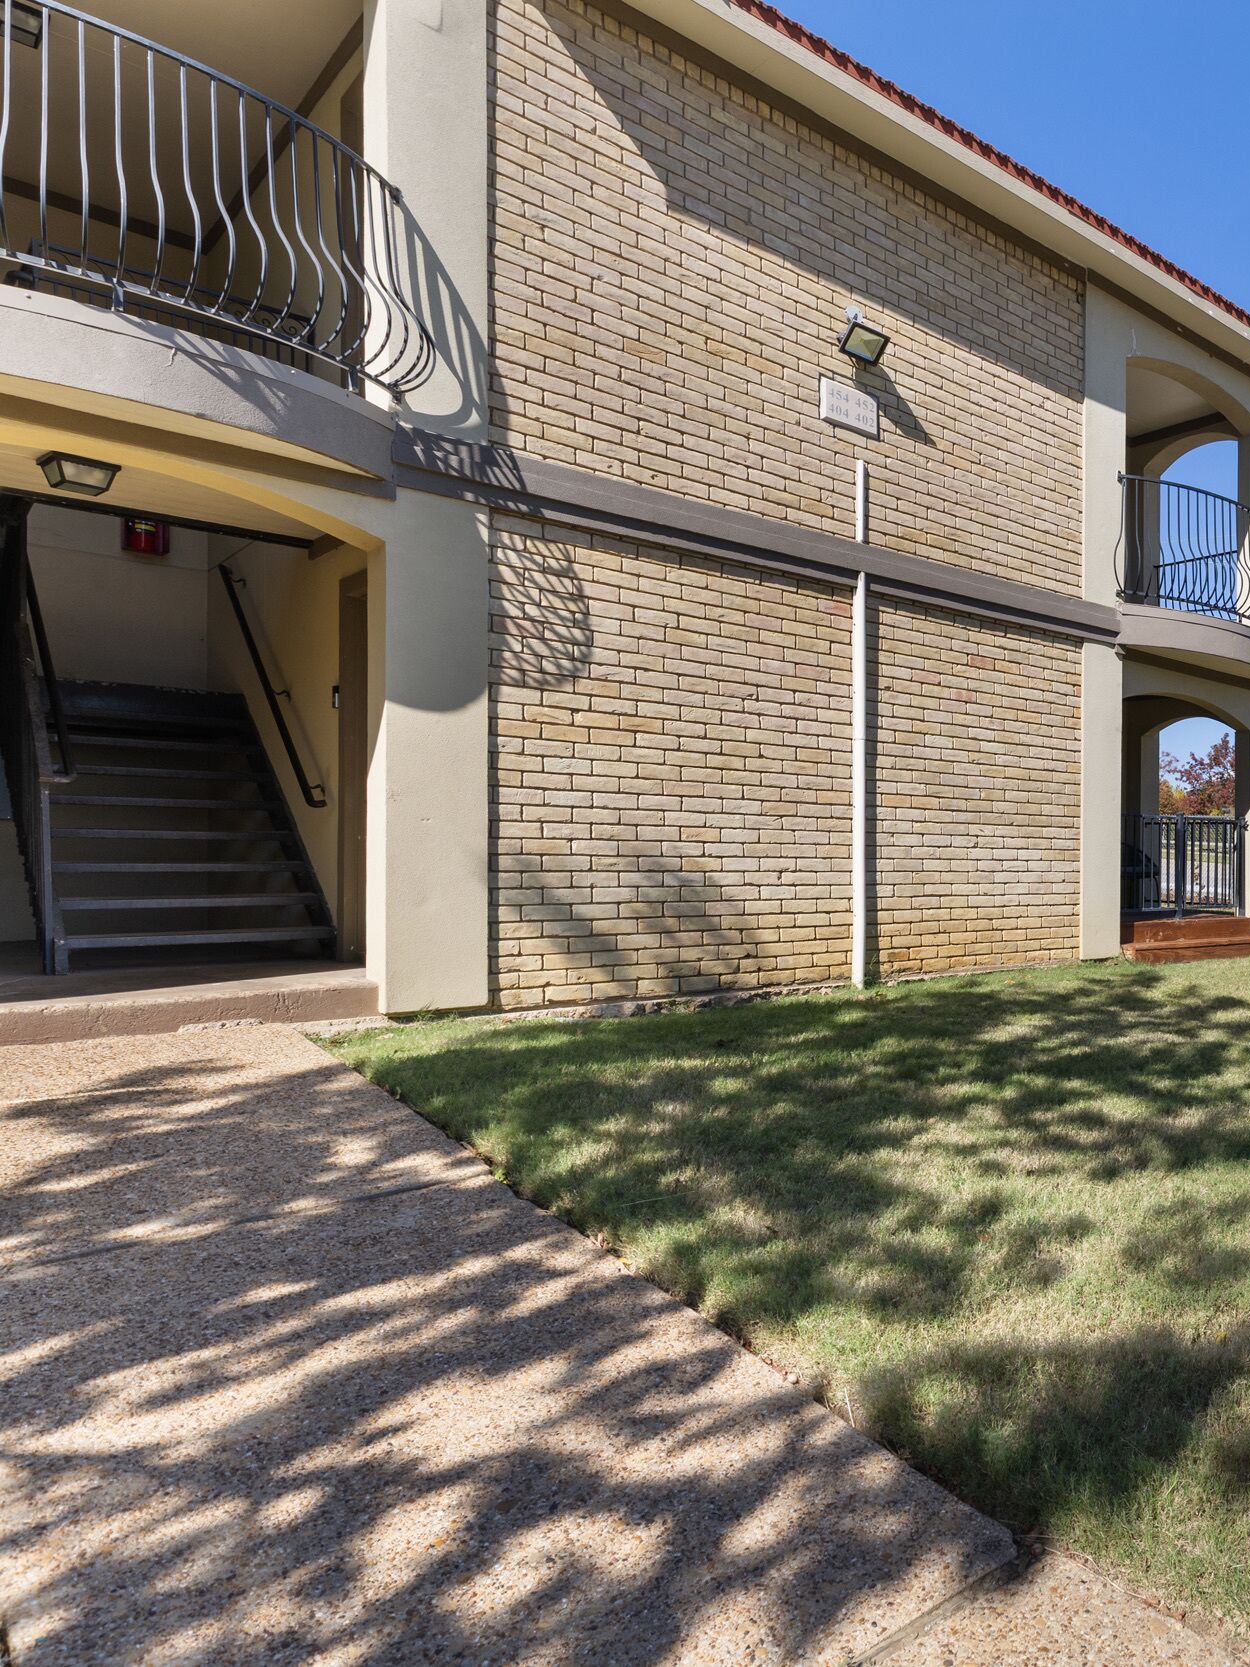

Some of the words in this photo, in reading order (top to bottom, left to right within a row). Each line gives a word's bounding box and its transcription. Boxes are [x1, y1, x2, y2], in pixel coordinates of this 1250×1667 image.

[828, 388, 850, 403] 454
[855, 397, 875, 413] 452
[828, 403, 849, 419] 404
[855, 413, 875, 428] 402
